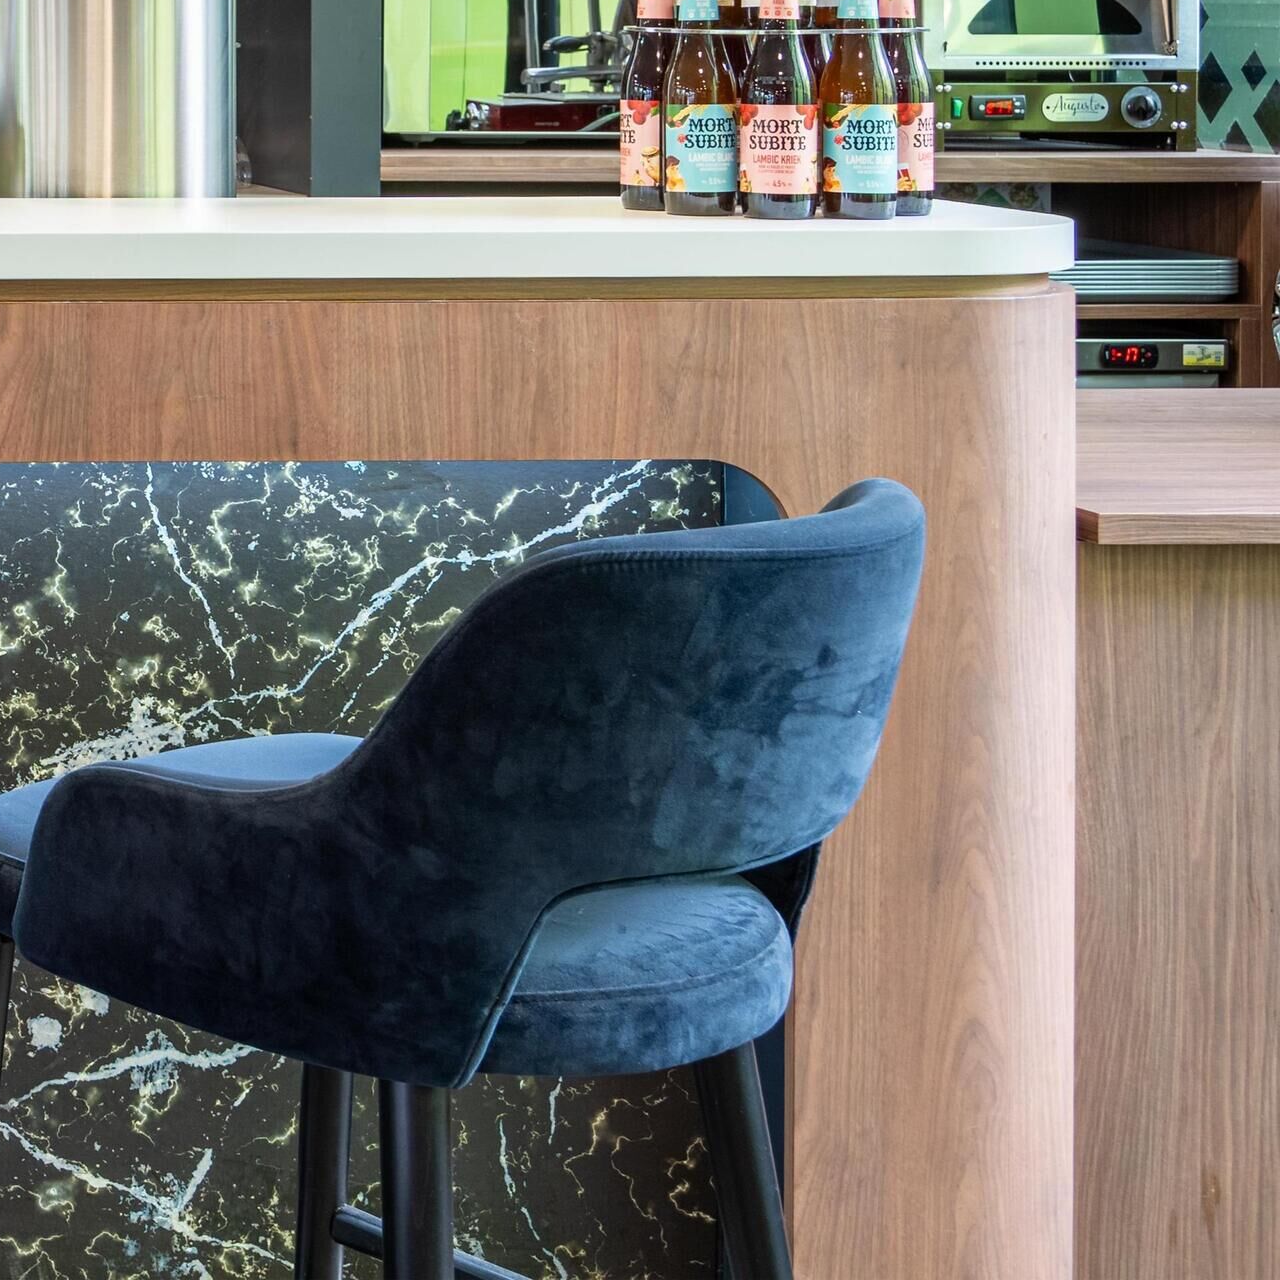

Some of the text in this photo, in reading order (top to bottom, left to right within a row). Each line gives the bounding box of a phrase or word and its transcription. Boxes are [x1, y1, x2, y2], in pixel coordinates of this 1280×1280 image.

[1052, 95, 1102, 116] Augusto
[688, 117, 735, 133] MORT
[752, 119, 803, 134] MORT
[846, 119, 894, 135] MORT
[684, 132, 736, 149] SUBITE
[749, 134, 806, 151] SUBITE
[841, 135, 896, 151] SUBITE
[752, 154, 801, 164] LAMBIC KRIEK
